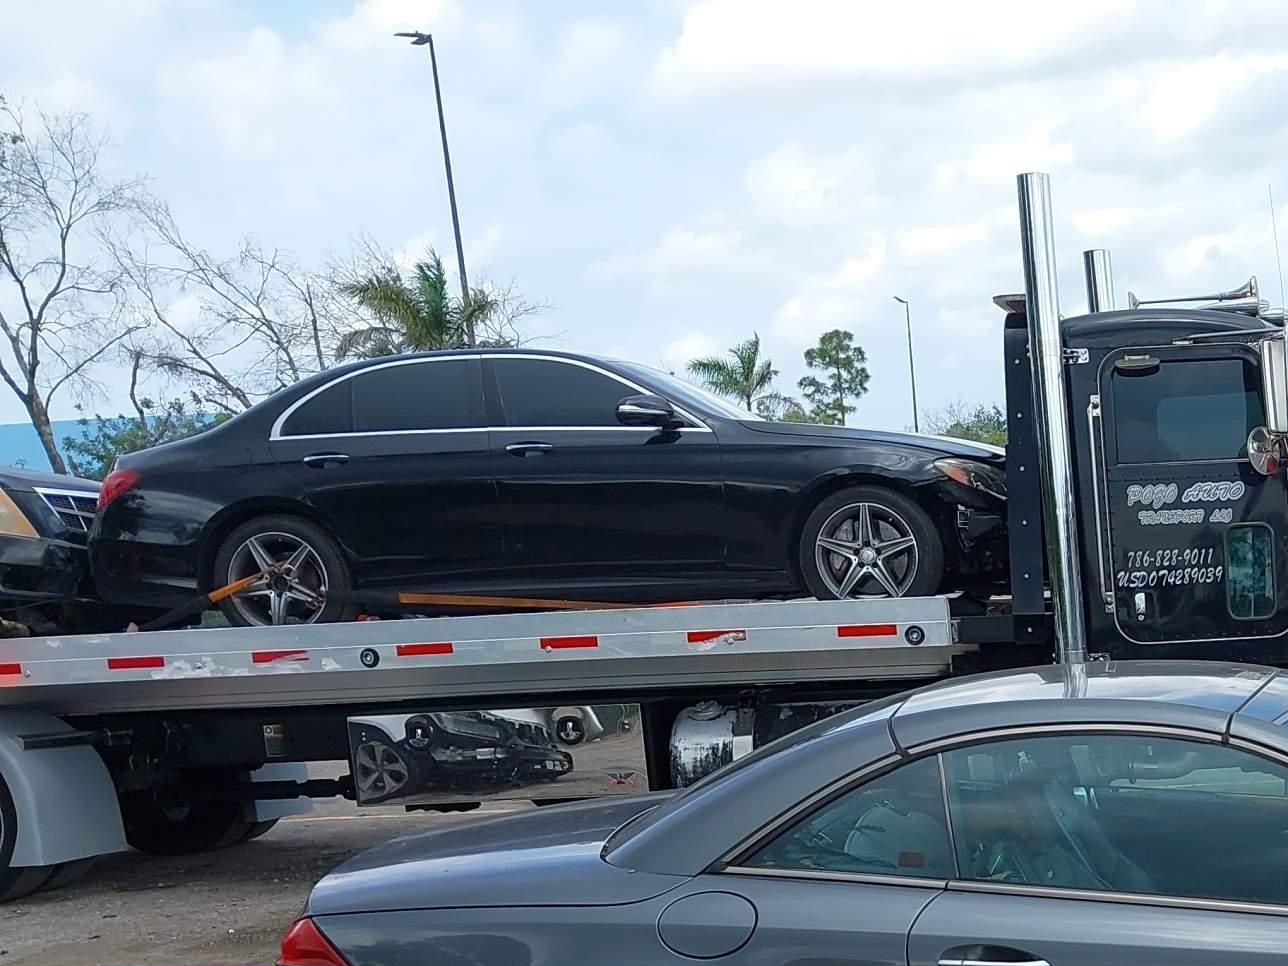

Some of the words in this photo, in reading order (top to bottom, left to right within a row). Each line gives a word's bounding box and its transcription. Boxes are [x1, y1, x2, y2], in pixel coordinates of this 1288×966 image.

[1182, 481, 1245, 502] AUTO
[1138, 510, 1204, 525] TRANSPORT
[1127, 548, 1213, 568] 786-828-9011
